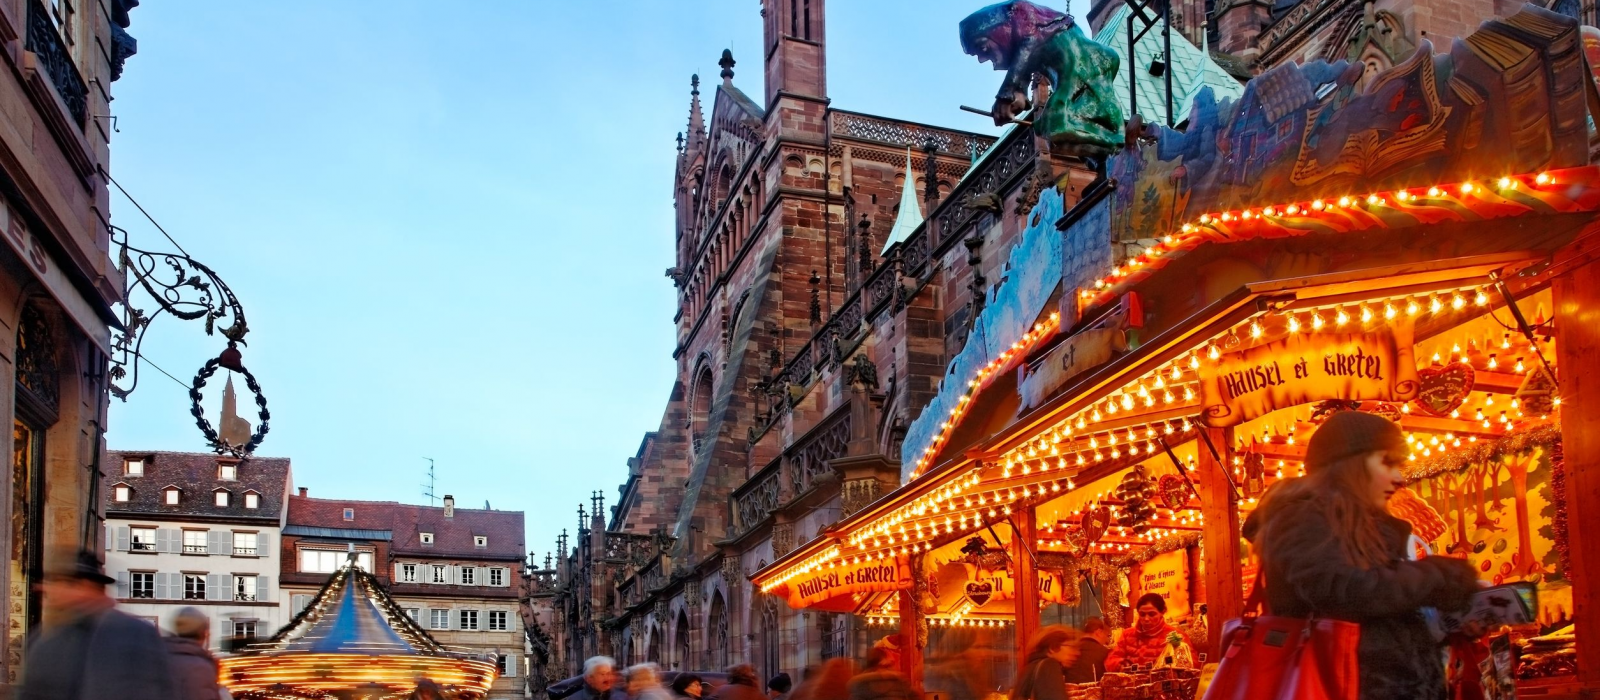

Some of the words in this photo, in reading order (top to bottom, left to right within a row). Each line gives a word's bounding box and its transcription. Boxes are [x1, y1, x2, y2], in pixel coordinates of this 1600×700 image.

[0, 193, 47, 274] ES
[1061, 344, 1076, 371] et
[1294, 357, 1309, 379] et
[845, 572, 855, 585] et
